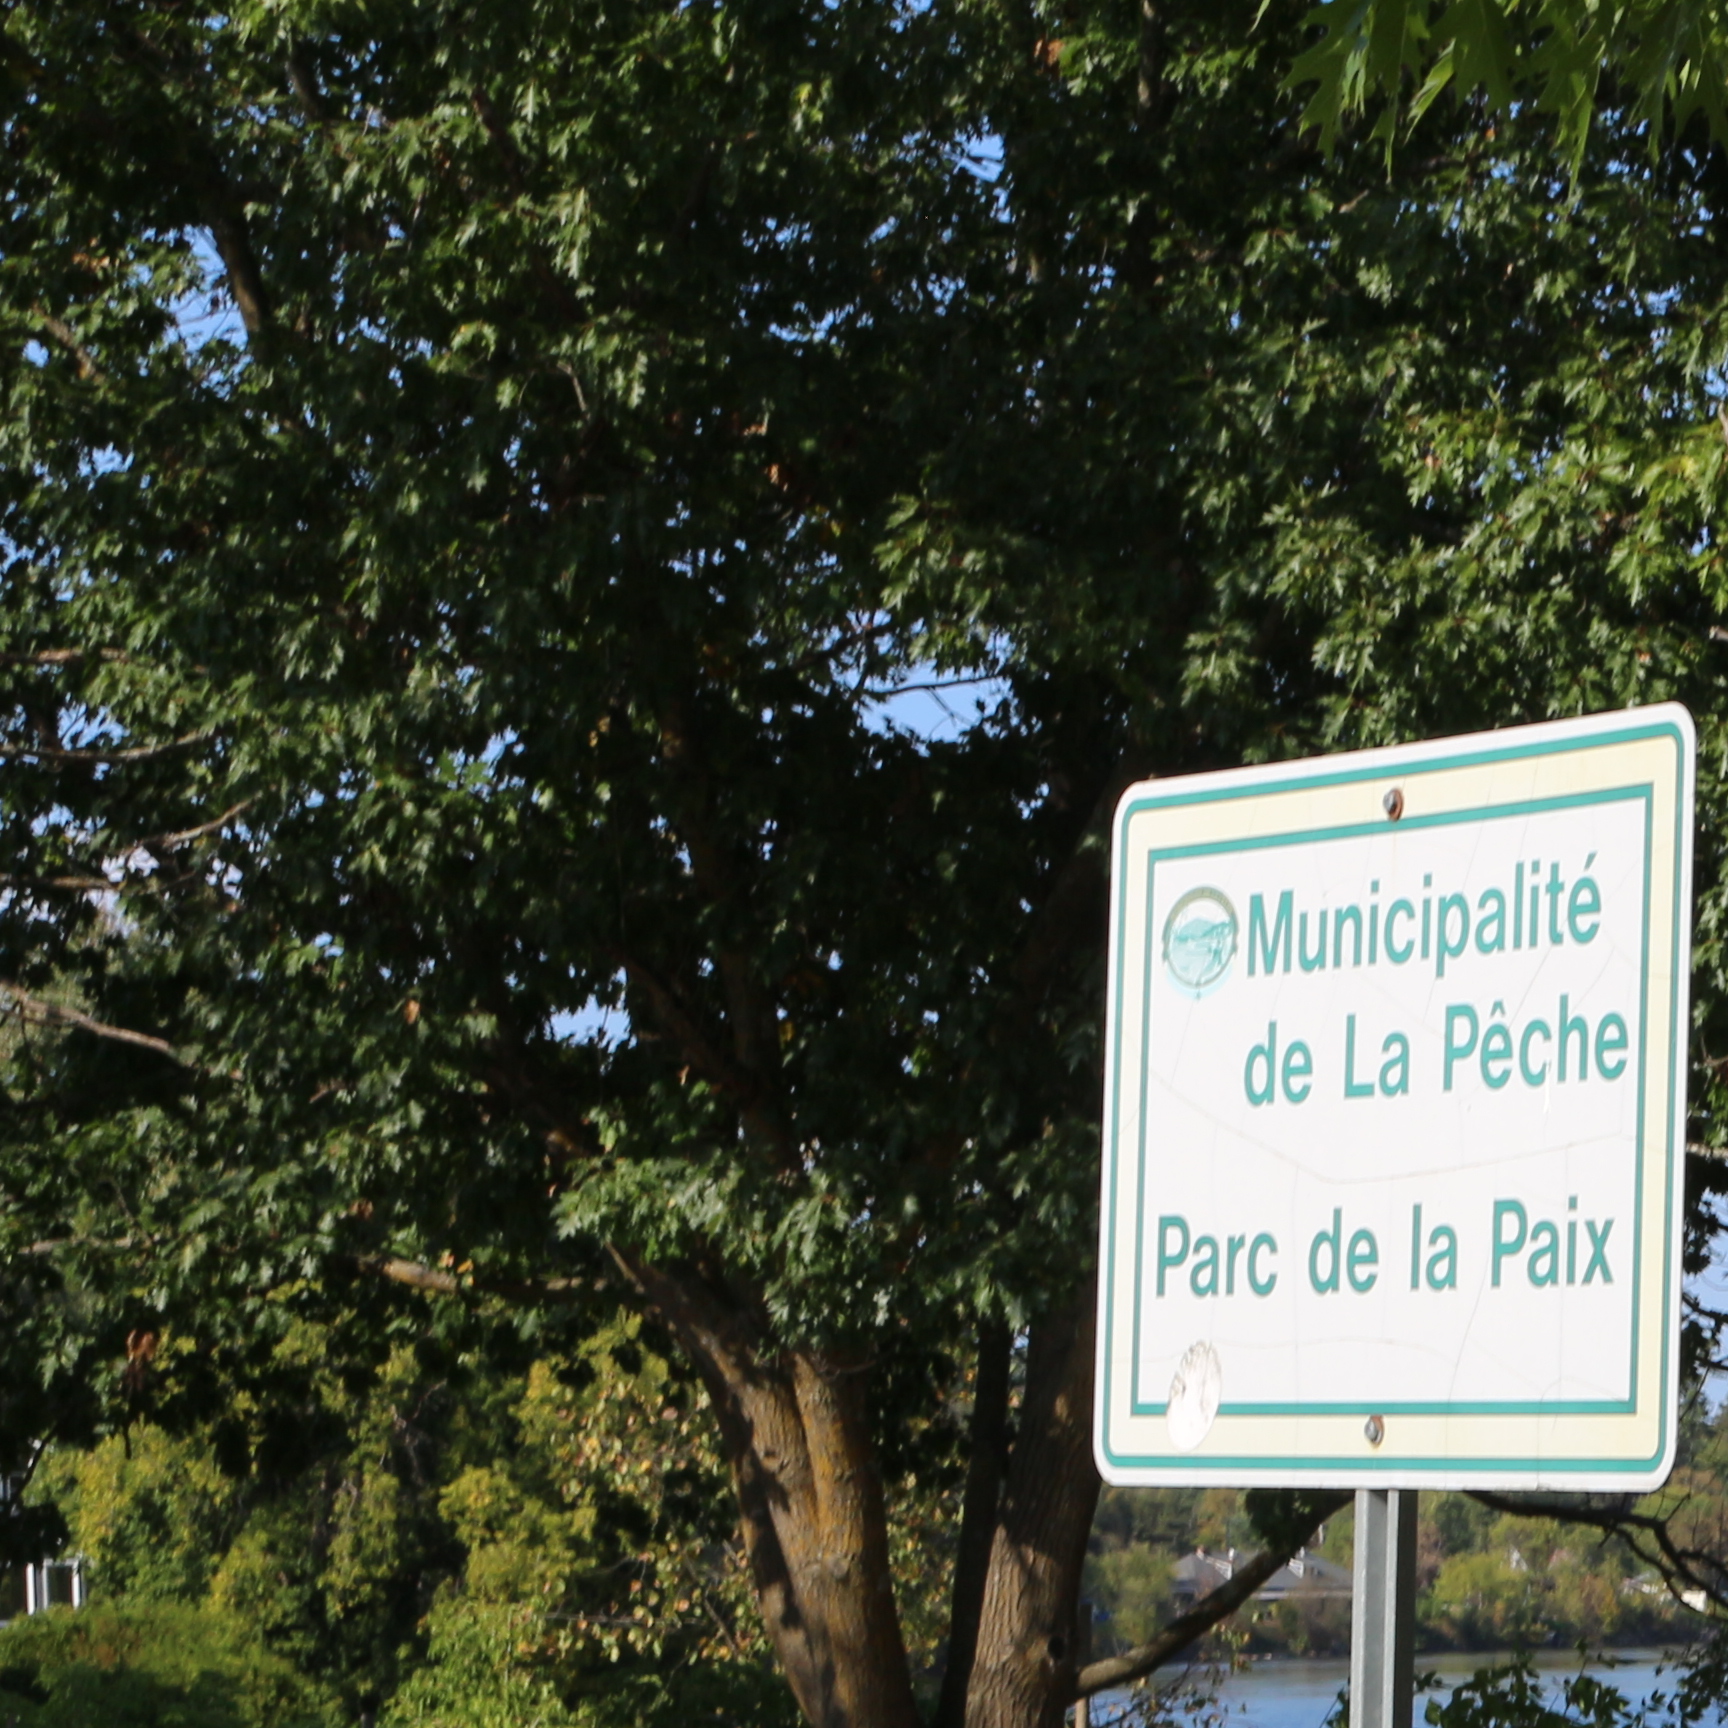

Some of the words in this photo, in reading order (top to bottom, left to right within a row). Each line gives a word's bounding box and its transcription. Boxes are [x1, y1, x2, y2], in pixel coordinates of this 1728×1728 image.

[1247, 853, 1602, 977] Municipalité
[1243, 1020, 1313, 1106] de
[1343, 1013, 1410, 1099] La
[1442, 993, 1630, 1092] Pêche
[1156, 1213, 1279, 1299] Parc
[1308, 1207, 1379, 1294] de
[1410, 1202, 1458, 1291] la
[1490, 1195, 1615, 1289] Paix
